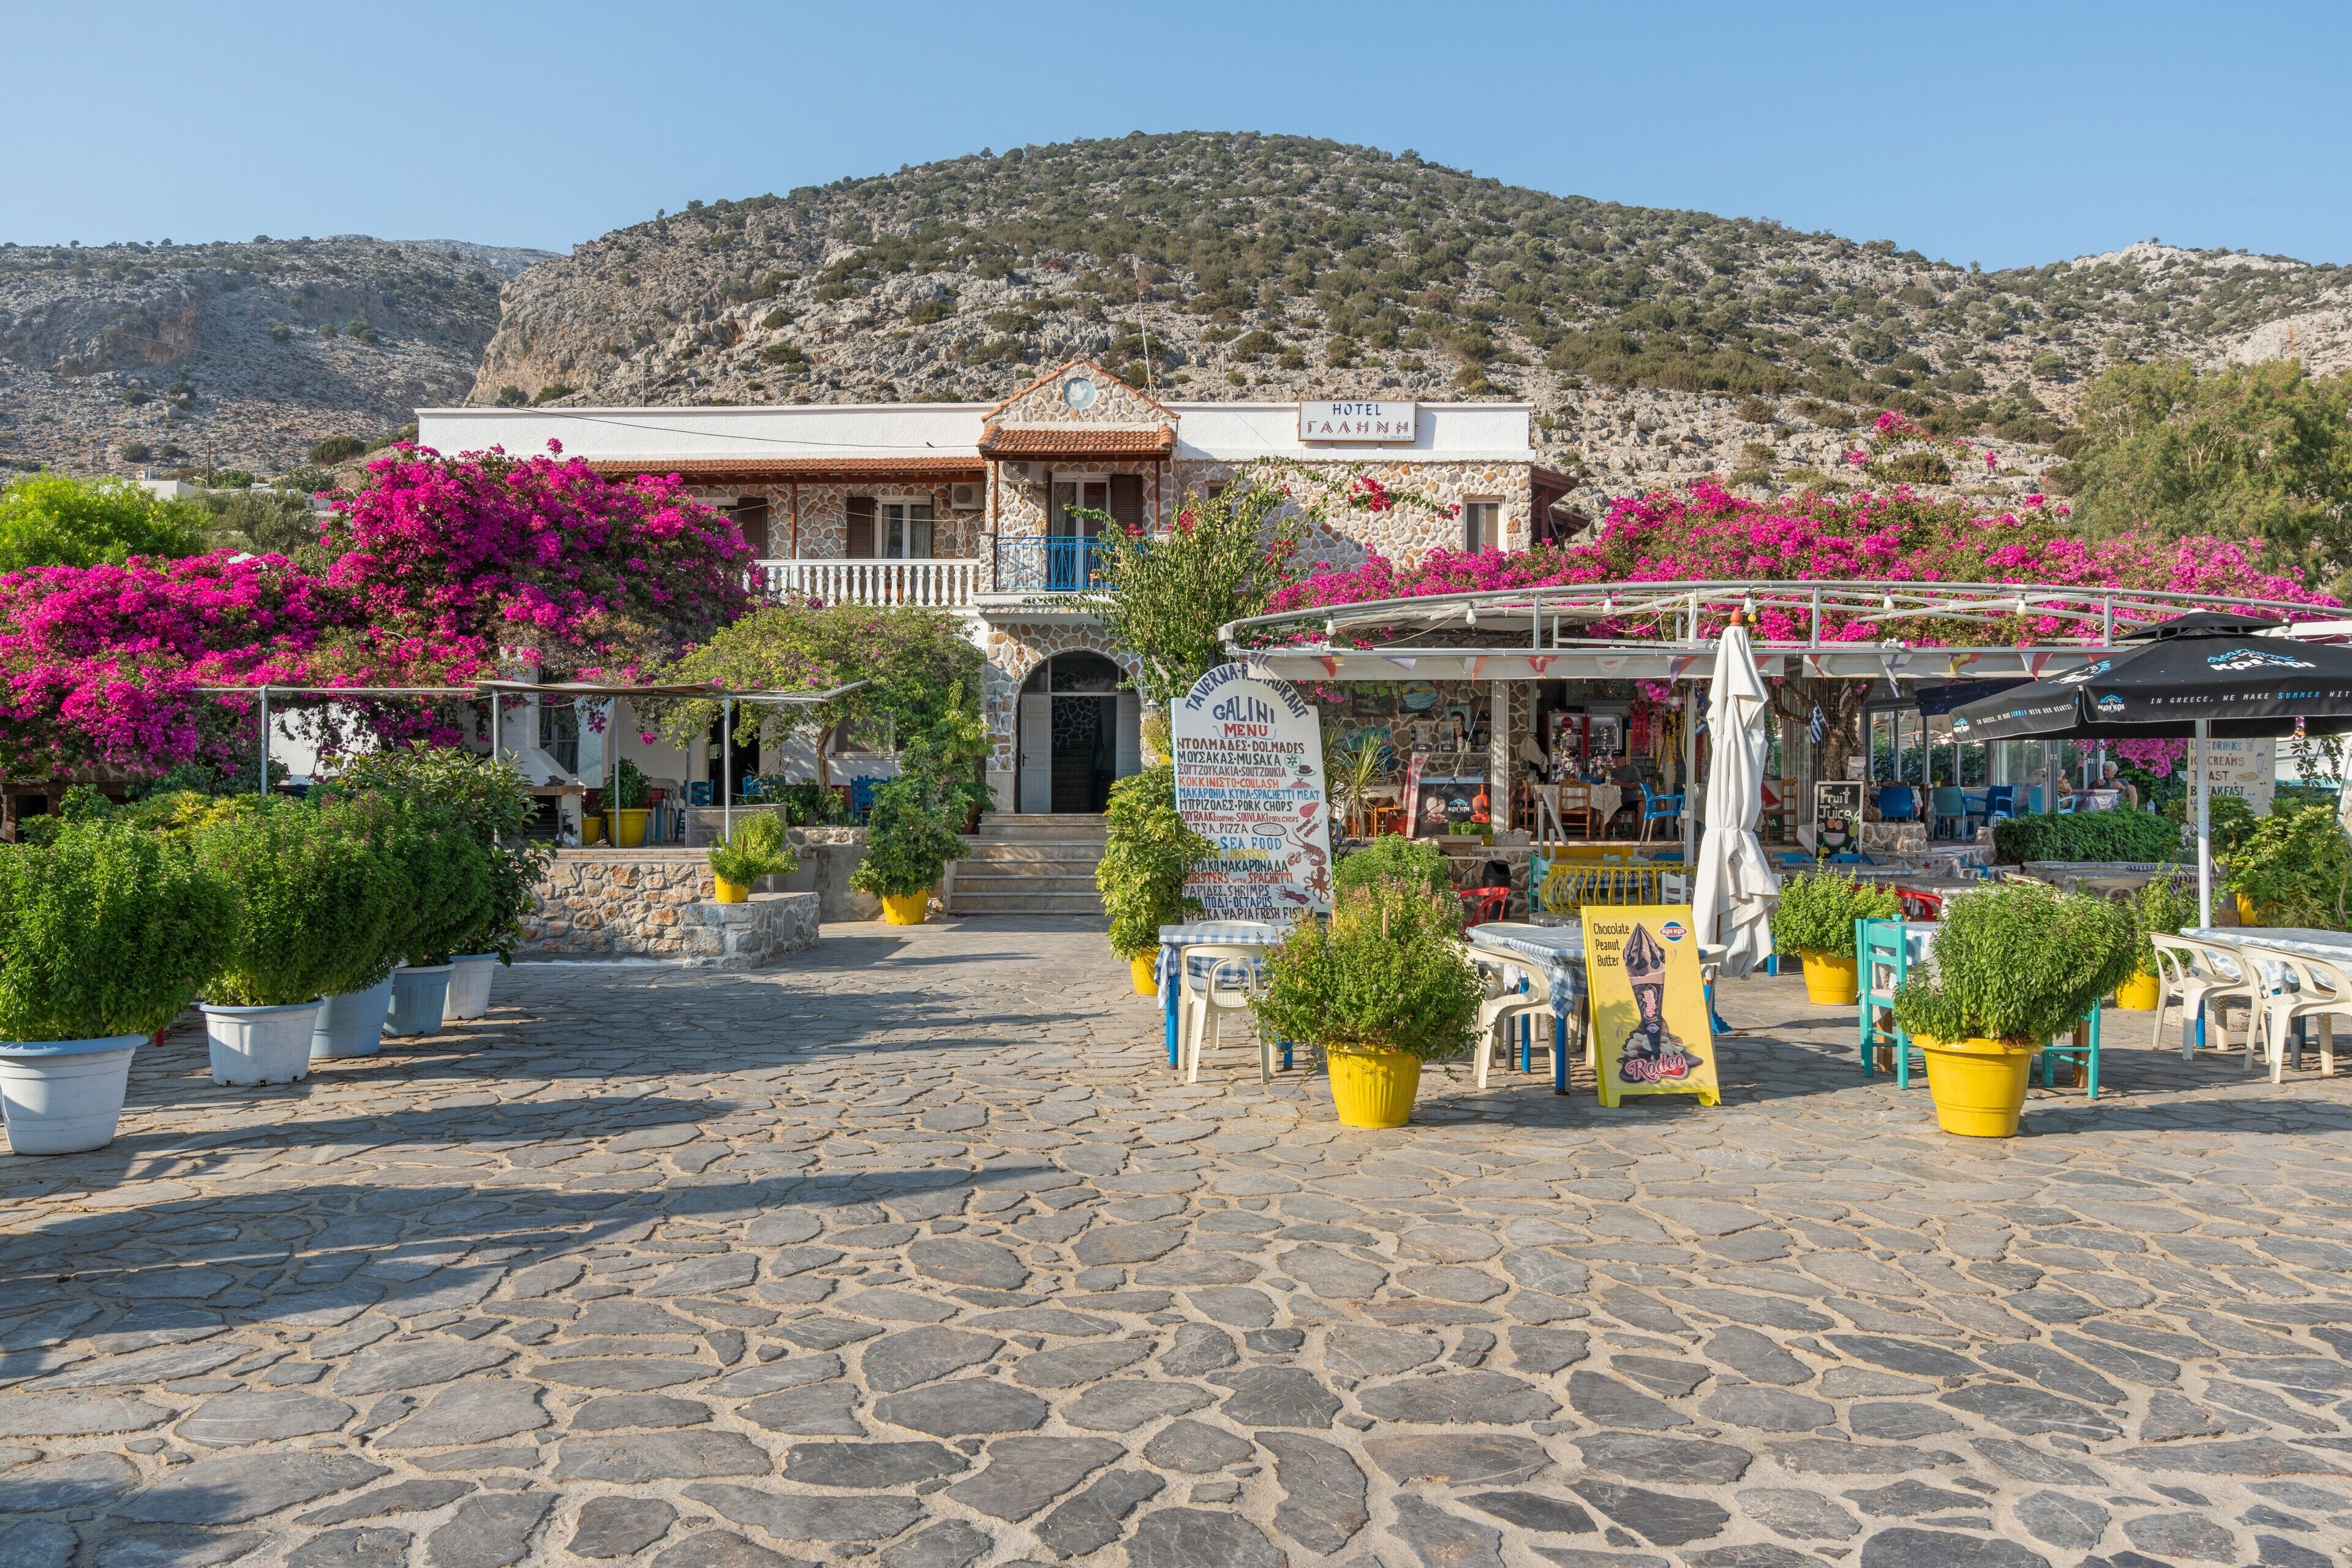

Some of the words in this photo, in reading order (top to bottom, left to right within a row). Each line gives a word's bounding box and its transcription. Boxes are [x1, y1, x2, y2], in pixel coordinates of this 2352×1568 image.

[1332, 404, 1382, 416] HOTEL
[1307, 421, 1408, 434] ΓΑΛΗΝΗ
[1213, 695, 1275, 724] GALINI
[1223, 723, 1268, 737] MENU
[2212, 741, 2242, 751] DRINKS
[2207, 756, 2245, 767] CREAMS
[2191, 770, 2229, 781] TAST
[1297, 790, 1320, 801] MEAT
[1820, 786, 1850, 804] Fruit
[2190, 786, 2245, 796] BAKFAST
[1263, 801, 1293, 812] CHOPS
[1819, 805, 1852, 820] Juice
[1186, 823, 1216, 834] ΙΤΣΑ
[1220, 836, 1246, 850] SEA
[1251, 837, 1282, 851] FOOD
[1256, 907, 1280, 920] FRESH
[1283, 907, 1304, 920] FIS
[1593, 922, 1629, 935] Chocolate
[1595, 939, 1620, 951] Peanut
[1597, 954, 1619, 967] Butter
[1642, 990, 1656, 1017] Rodeo
[1625, 1052, 1686, 1082] Rodeo
